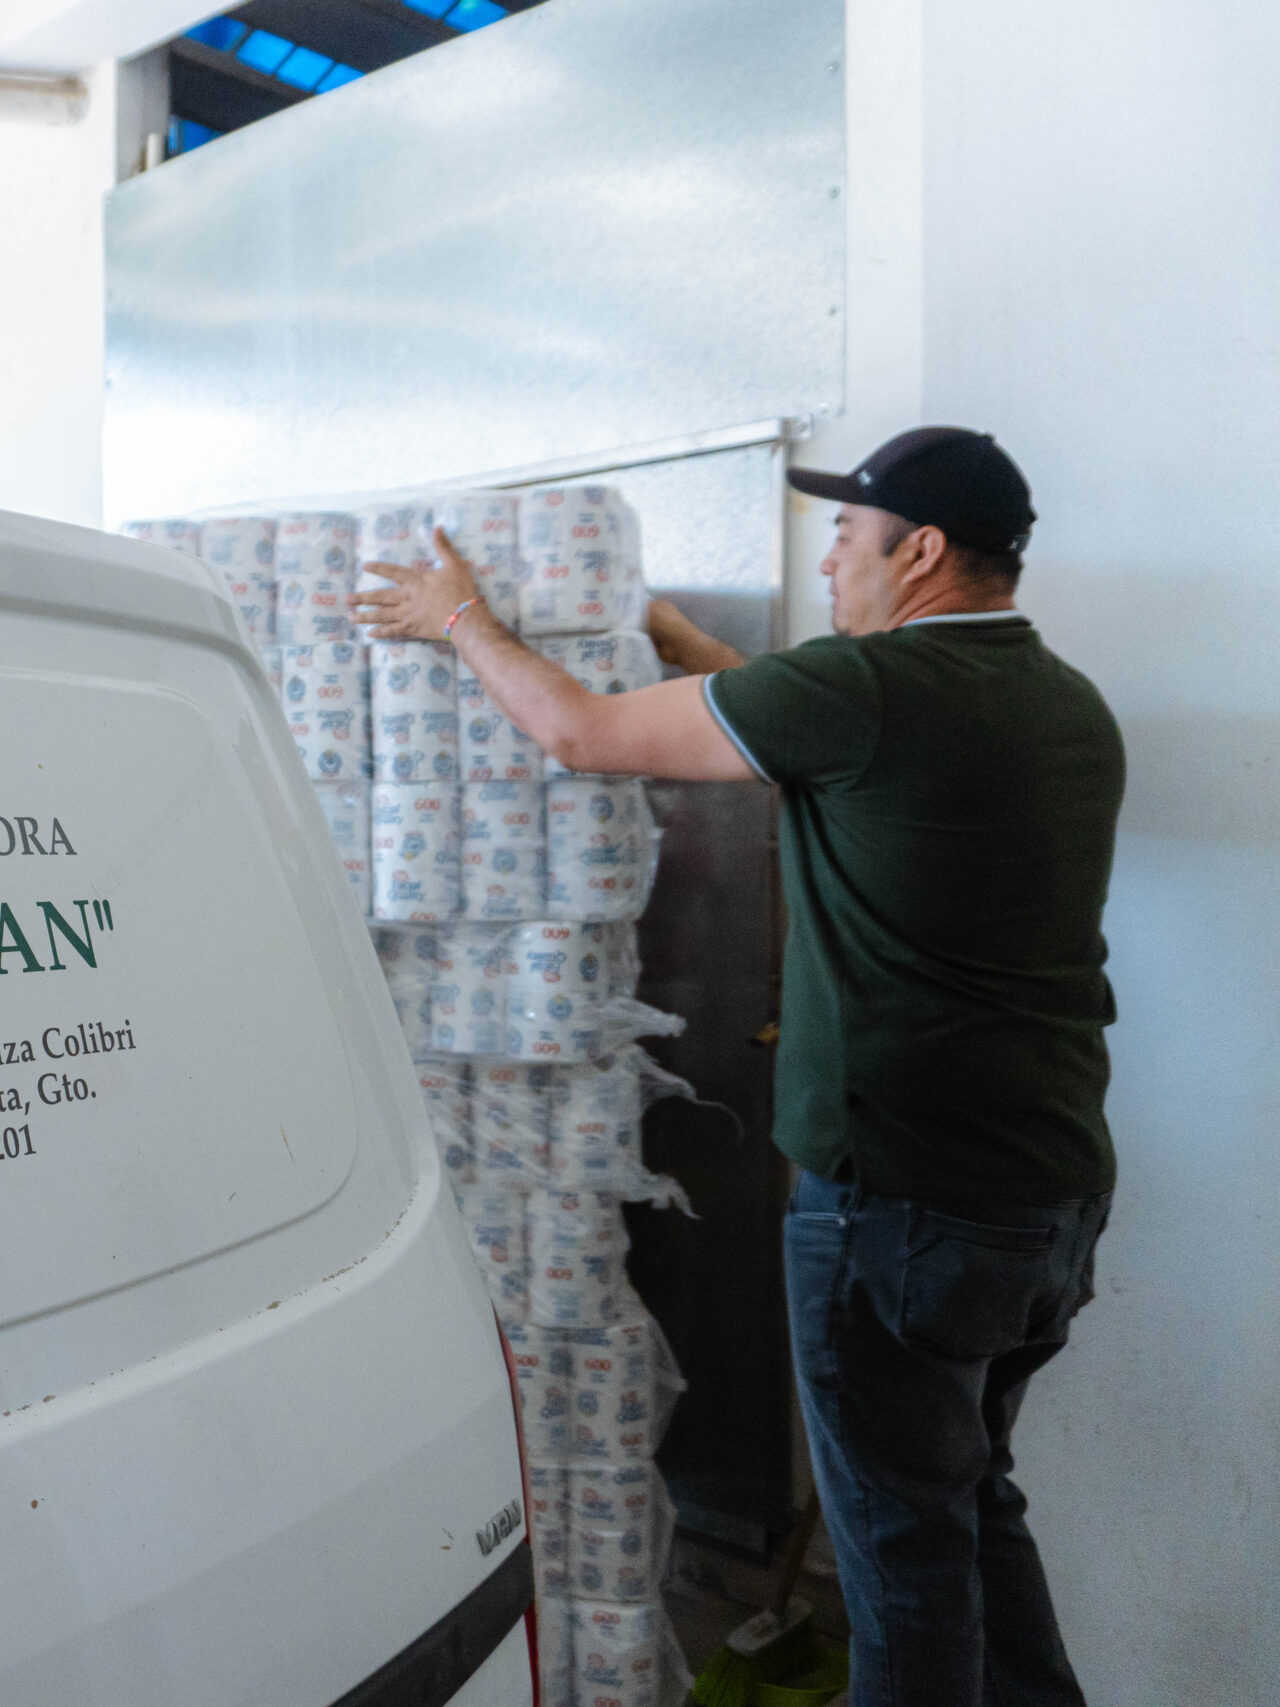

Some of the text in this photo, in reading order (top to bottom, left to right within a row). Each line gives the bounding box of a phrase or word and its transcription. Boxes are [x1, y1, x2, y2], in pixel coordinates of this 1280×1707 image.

[317, 685, 344, 699] 600
[414, 799, 441, 811] 600
[503, 812, 530, 825] 600
[542, 926, 570, 940] 600
[42, 1019, 137, 1058] Colibri
[533, 1042, 562, 1056] 600
[38, 1073, 97, 1107] Gto.
